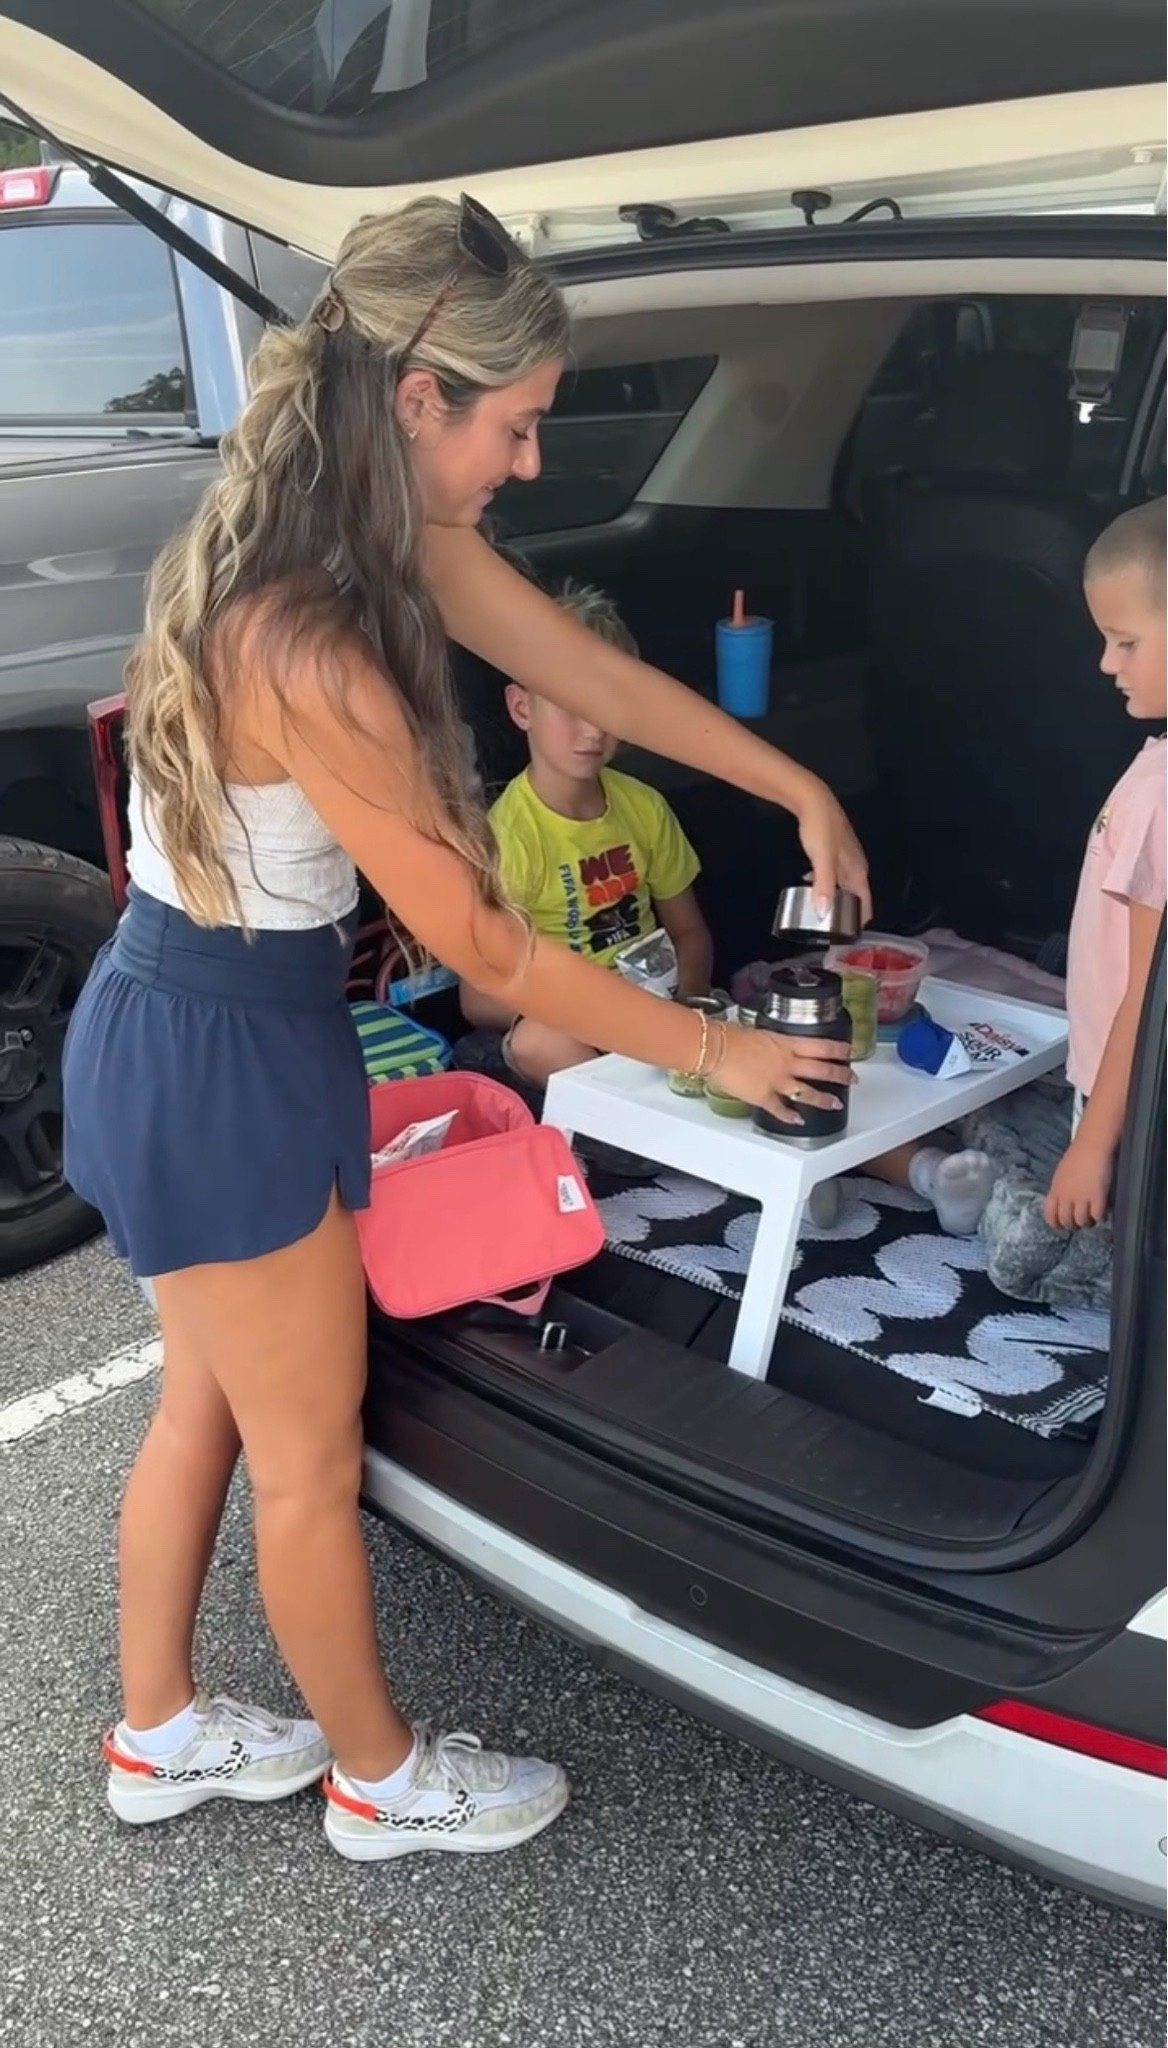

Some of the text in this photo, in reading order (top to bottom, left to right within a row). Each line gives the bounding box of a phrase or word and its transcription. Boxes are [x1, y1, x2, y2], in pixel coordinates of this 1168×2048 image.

[558, 863, 576, 896] FIFA
[578, 844, 635, 885] WE
[586, 870, 639, 908] ARE
[974, 1022, 1018, 1051] Daisy
